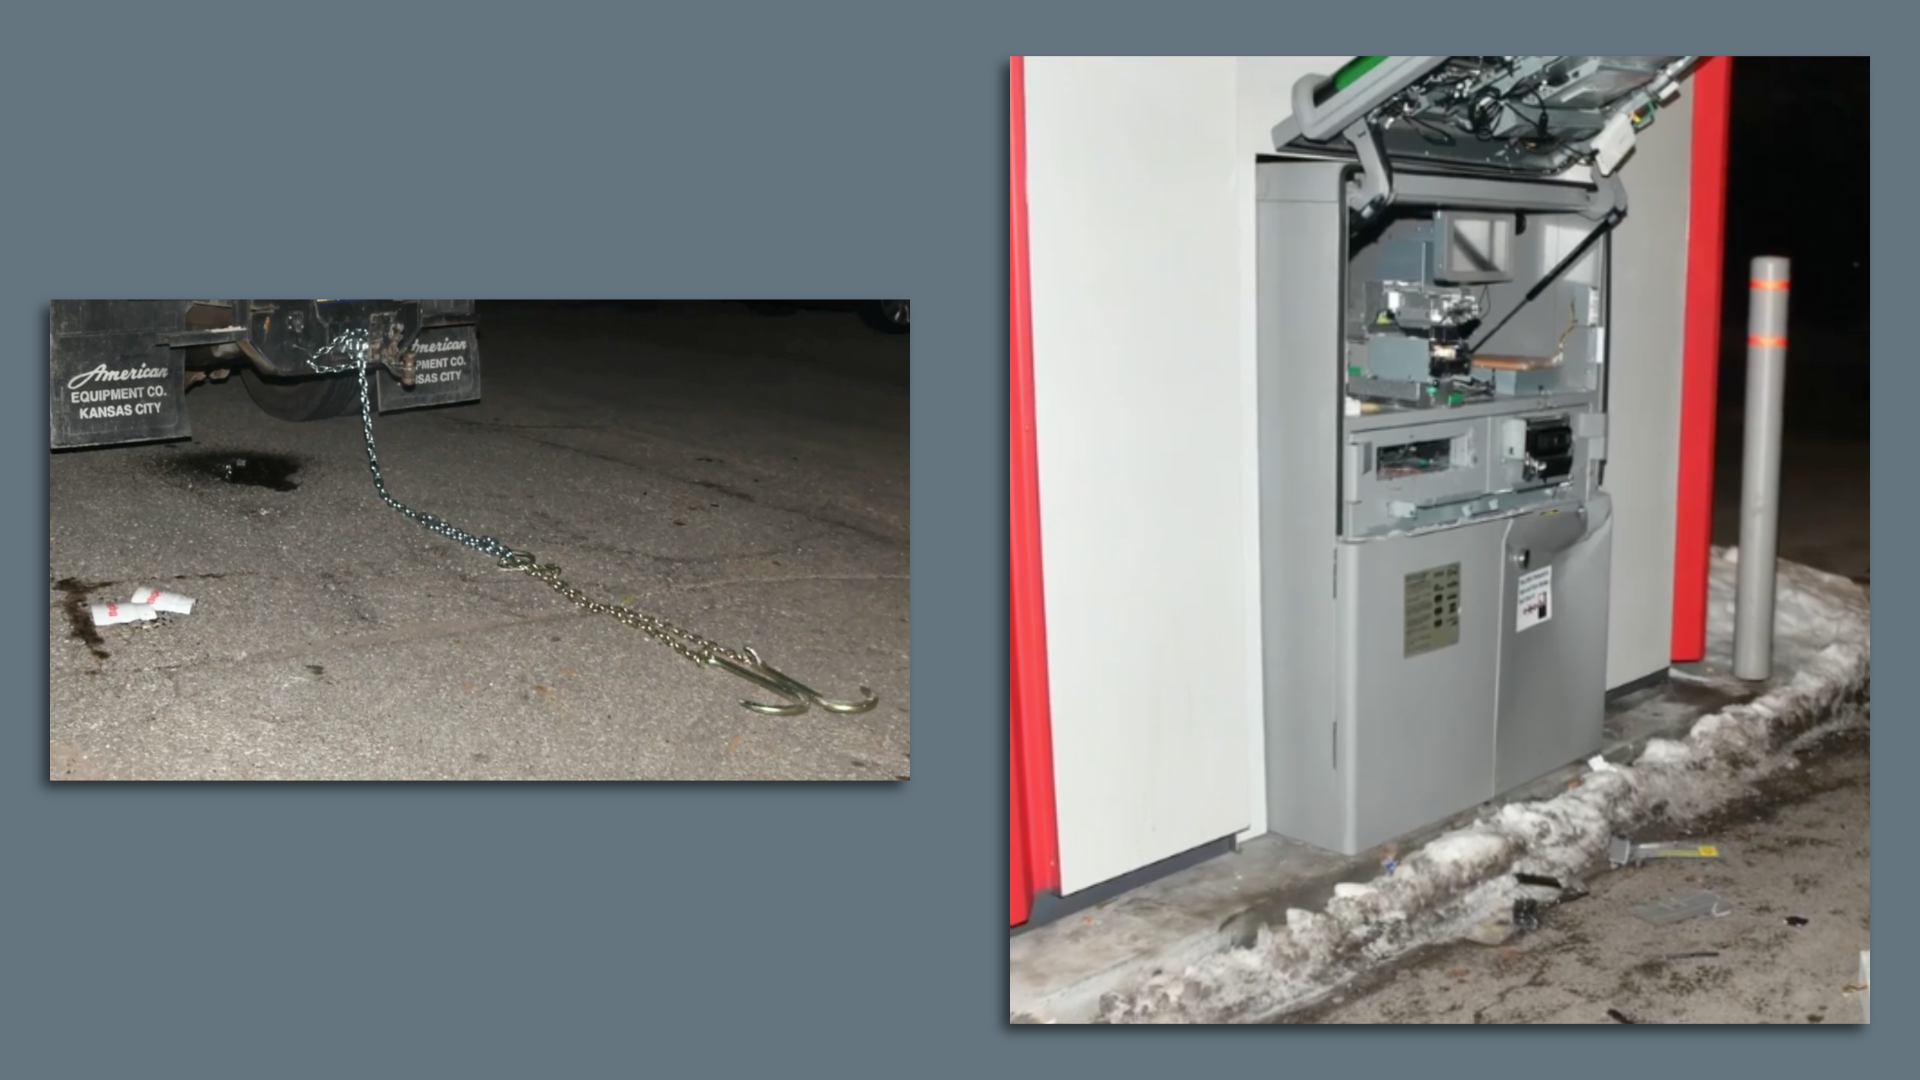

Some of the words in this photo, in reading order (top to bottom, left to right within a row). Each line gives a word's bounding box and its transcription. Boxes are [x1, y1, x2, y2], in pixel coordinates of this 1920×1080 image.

[415, 358, 449, 370] PMENT
[450, 356, 466, 366] CO.
[67, 362, 168, 389] American
[415, 373, 438, 384] SAS
[440, 370, 462, 382] CITY
[71, 387, 144, 403] EQUIPMENT
[147, 385, 167, 397] CO.
[79, 404, 132, 419] KANSAS
[135, 402, 161, 415] CITY
